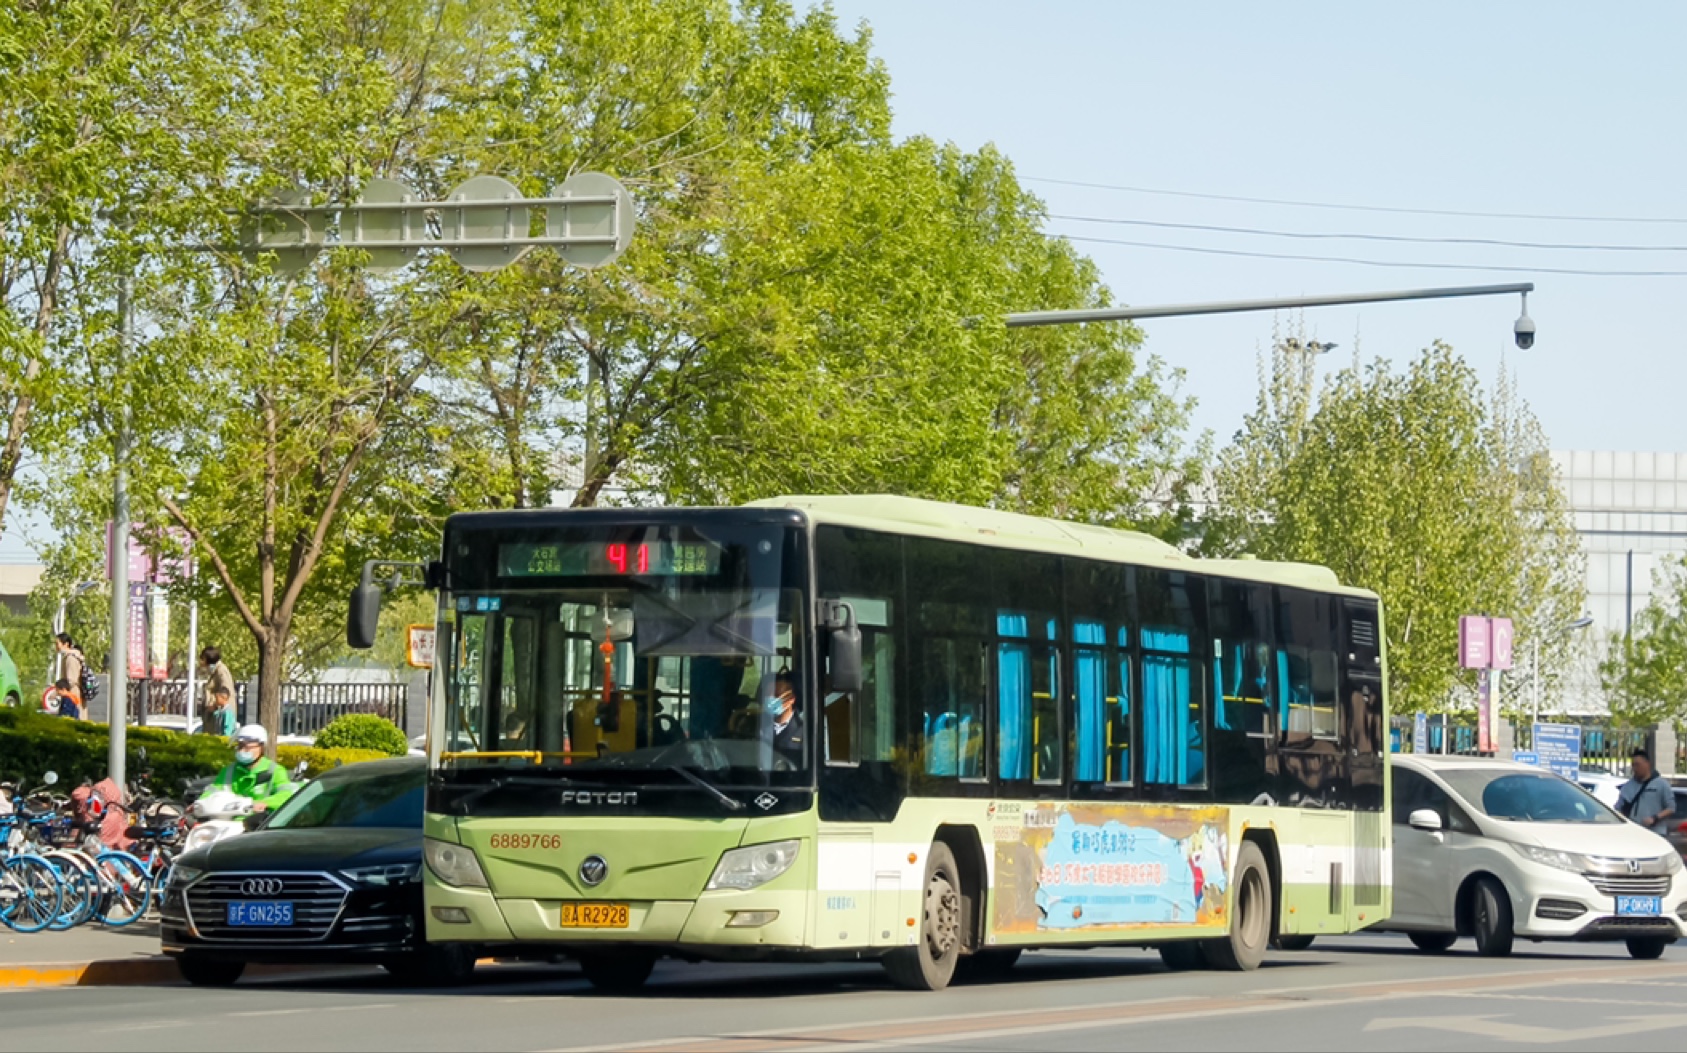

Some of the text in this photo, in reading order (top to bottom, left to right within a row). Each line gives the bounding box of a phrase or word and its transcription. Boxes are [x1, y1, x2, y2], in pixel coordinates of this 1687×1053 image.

[606, 543, 648, 573] 41
[1496, 627, 1508, 662] C
[562, 791, 638, 805] FOTON
[490, 833, 561, 849] 6889766
